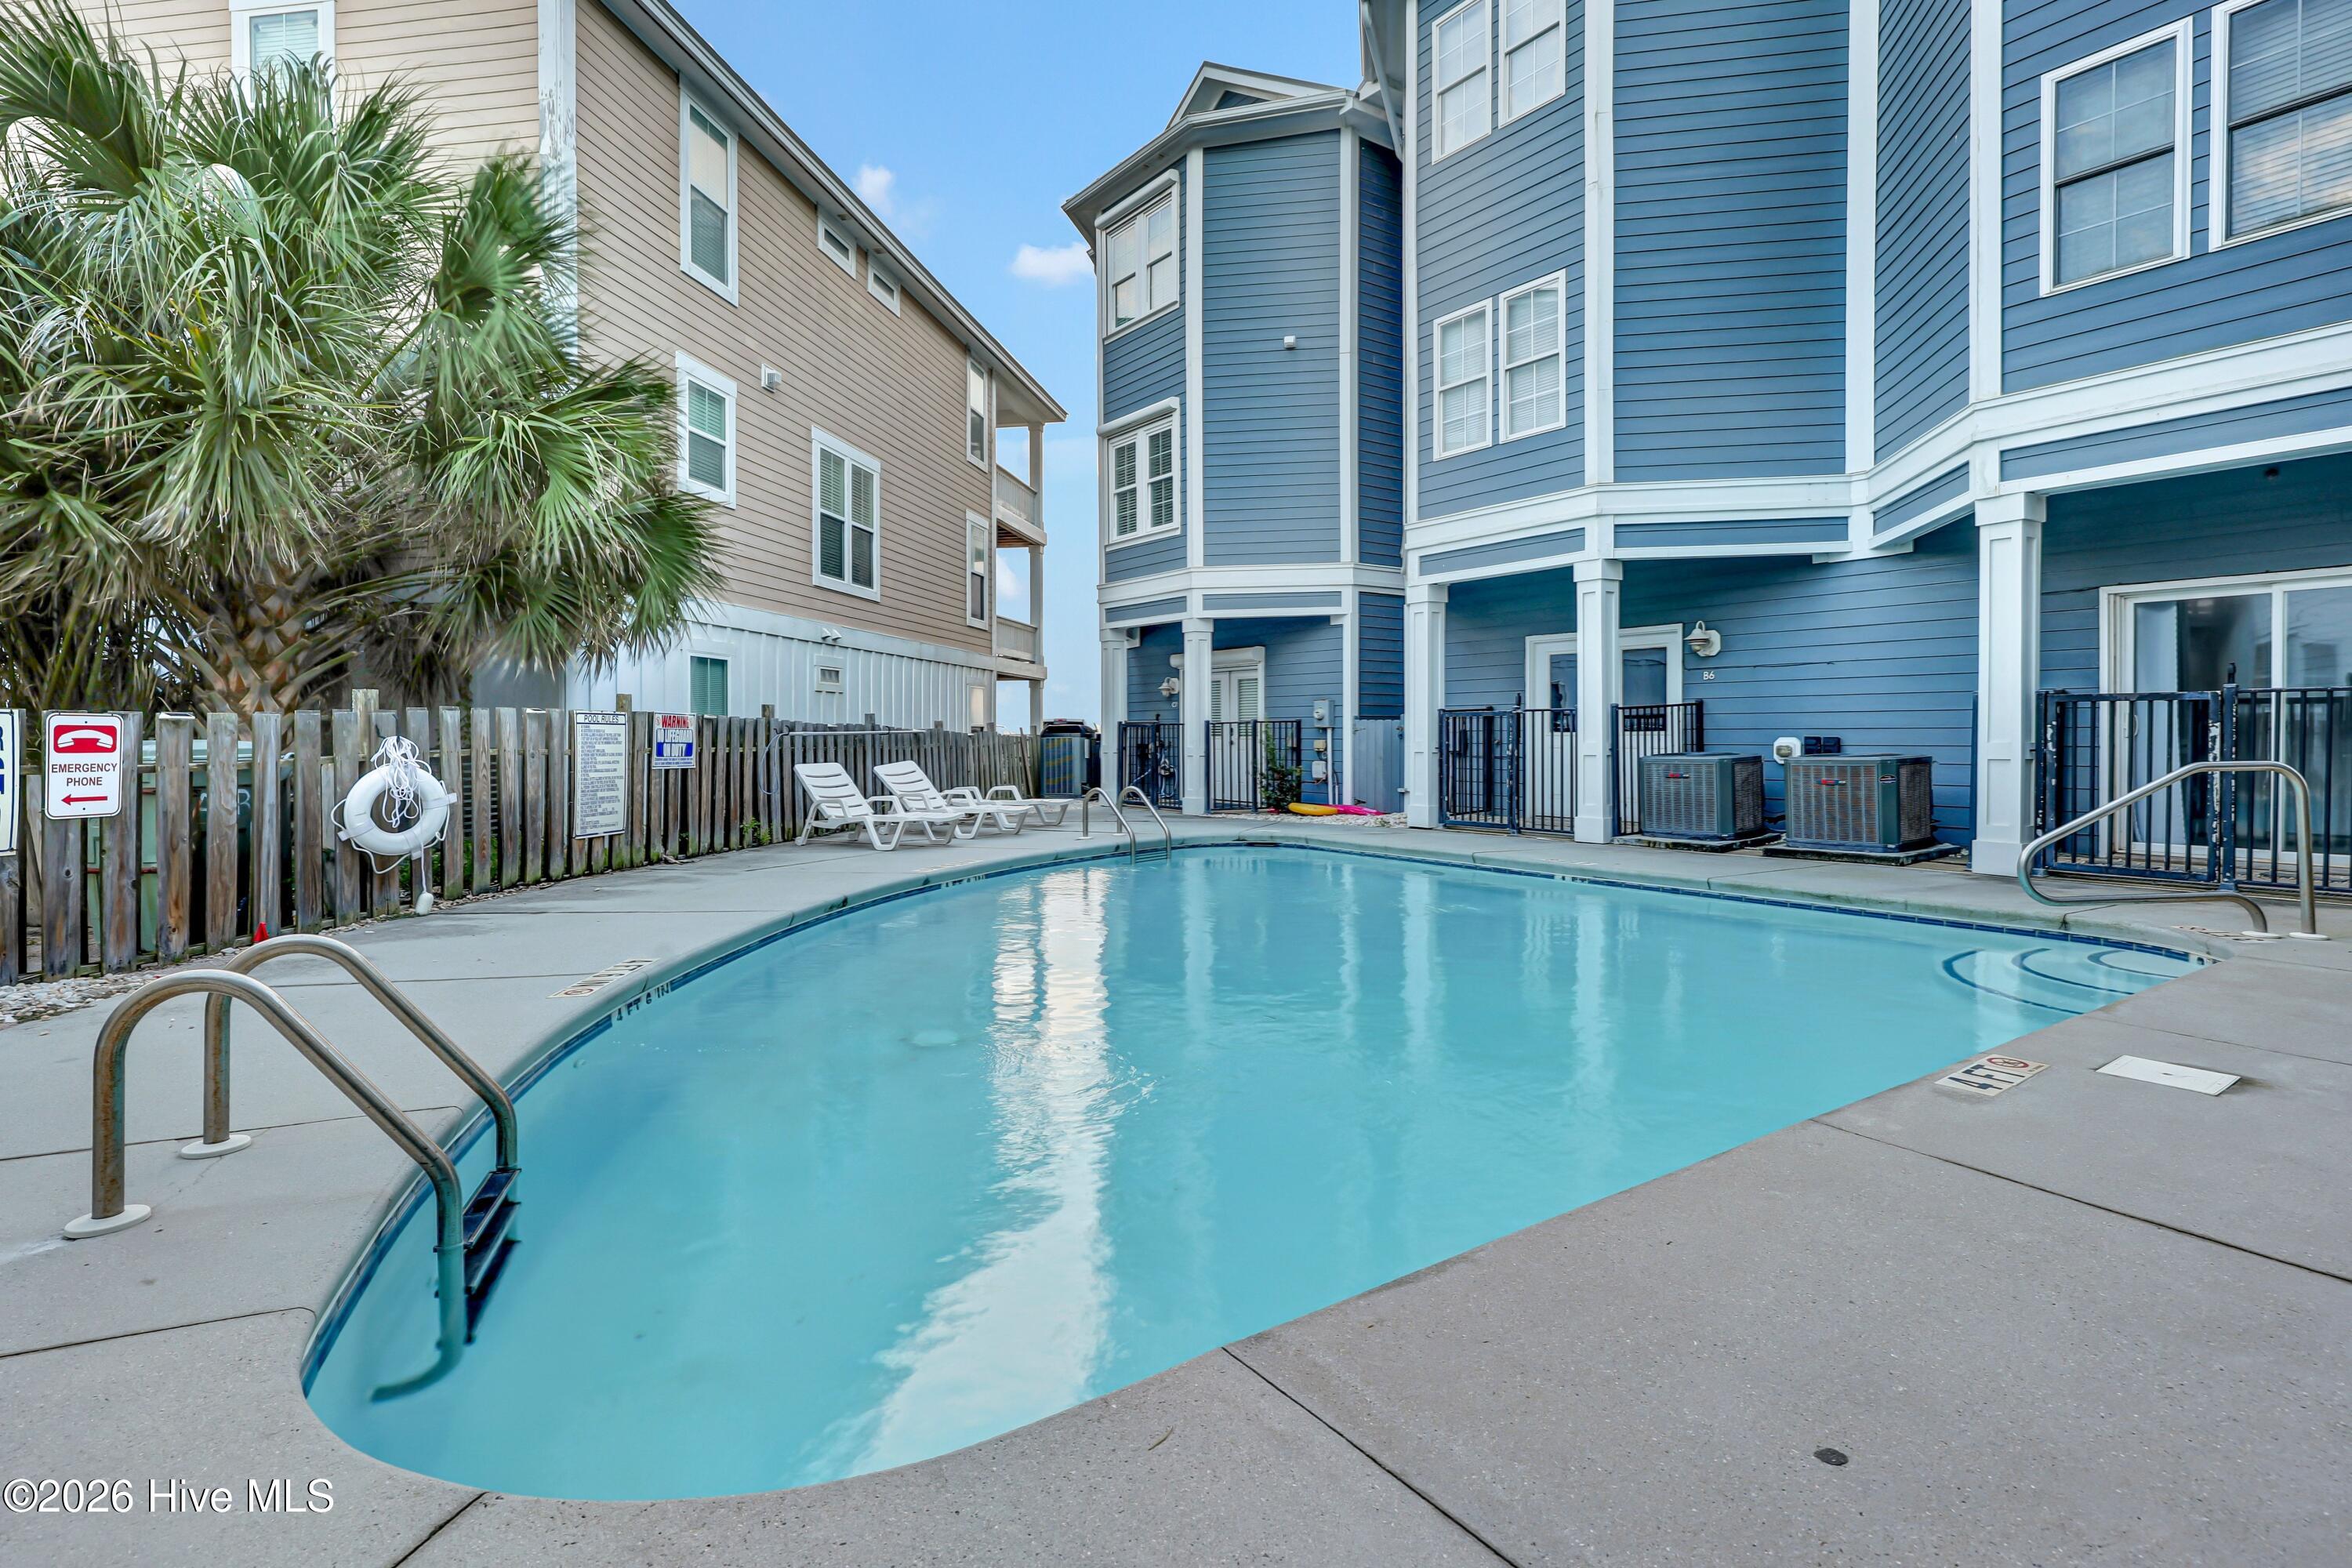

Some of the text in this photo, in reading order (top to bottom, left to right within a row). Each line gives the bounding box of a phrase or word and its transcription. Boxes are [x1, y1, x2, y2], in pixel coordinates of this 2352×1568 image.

[1703, 670, 1715, 681] B6
[583, 714, 619, 724] POOL RULES
[657, 728, 693, 742] NO LIFEGUARD
[663, 742, 687, 757] ON DUTY
[51, 763, 118, 773] EMERGENCY
[66, 776, 103, 787] PHONE
[626, 996, 641, 1016] FT
[645, 992, 652, 1004] 6
[657, 982, 670, 998] IN
[1961, 1064, 2026, 1084] FT
[1947, 1076, 2004, 1091] 4
